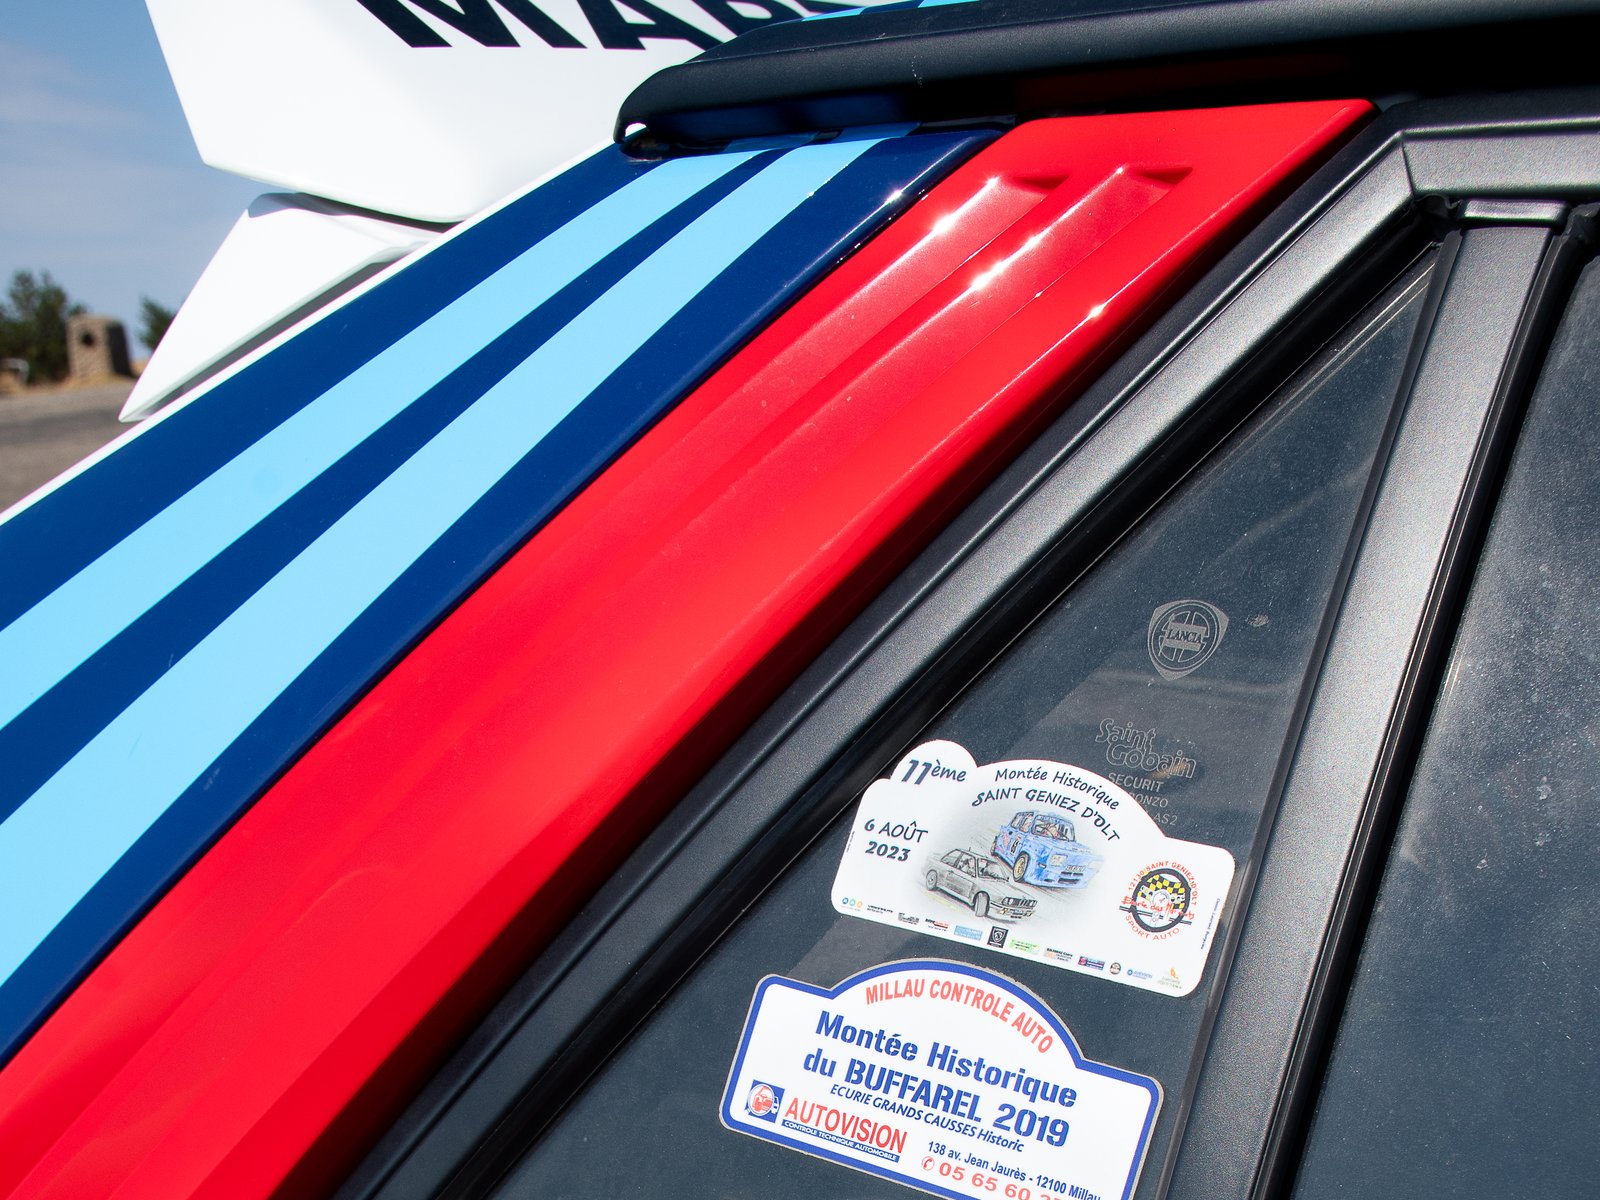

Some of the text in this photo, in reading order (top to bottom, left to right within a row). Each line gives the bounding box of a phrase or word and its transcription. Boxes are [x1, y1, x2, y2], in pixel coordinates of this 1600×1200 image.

[1166, 627, 1202, 644] LANCIA
[1095, 718, 1157, 750] Saint
[901, 759, 967, 784] 11ème
[1106, 744, 1197, 778] Gobain
[995, 766, 1119, 811] Montée Historique
[1108, 772, 1164, 792] SECURIT
[864, 818, 928, 843] 6 AOÛT
[972, 787, 1121, 842] SAINT GENIEZ D'OLT
[865, 841, 910, 862] 2023
[1145, 861, 1168, 871] SAINT
[1125, 914, 1180, 940] SPORT AUTO
[865, 978, 1053, 1054] MILLAU CONTROLE AUTO
[816, 1011, 1078, 1108] Montée Historique
[803, 1049, 1070, 1147] du BUFFAREL 2019
[784, 1097, 908, 1154] AUTOVISION
[830, 1084, 1024, 1152] ECURIE GRANDS CAUSSES Historic
[784, 1121, 897, 1161] CONTROLE TECHNIQUE AUTOMOBILE
[928, 1141, 946, 1156] 138
[948, 1149, 961, 1161] av.
[964, 1153, 989, 1170] Jean
[991, 1161, 1027, 1181] Jaurès
[1036, 1175, 1066, 1194] 12100
[939, 1162, 966, 1181] 05
[971, 1173, 998, 1192] 65
